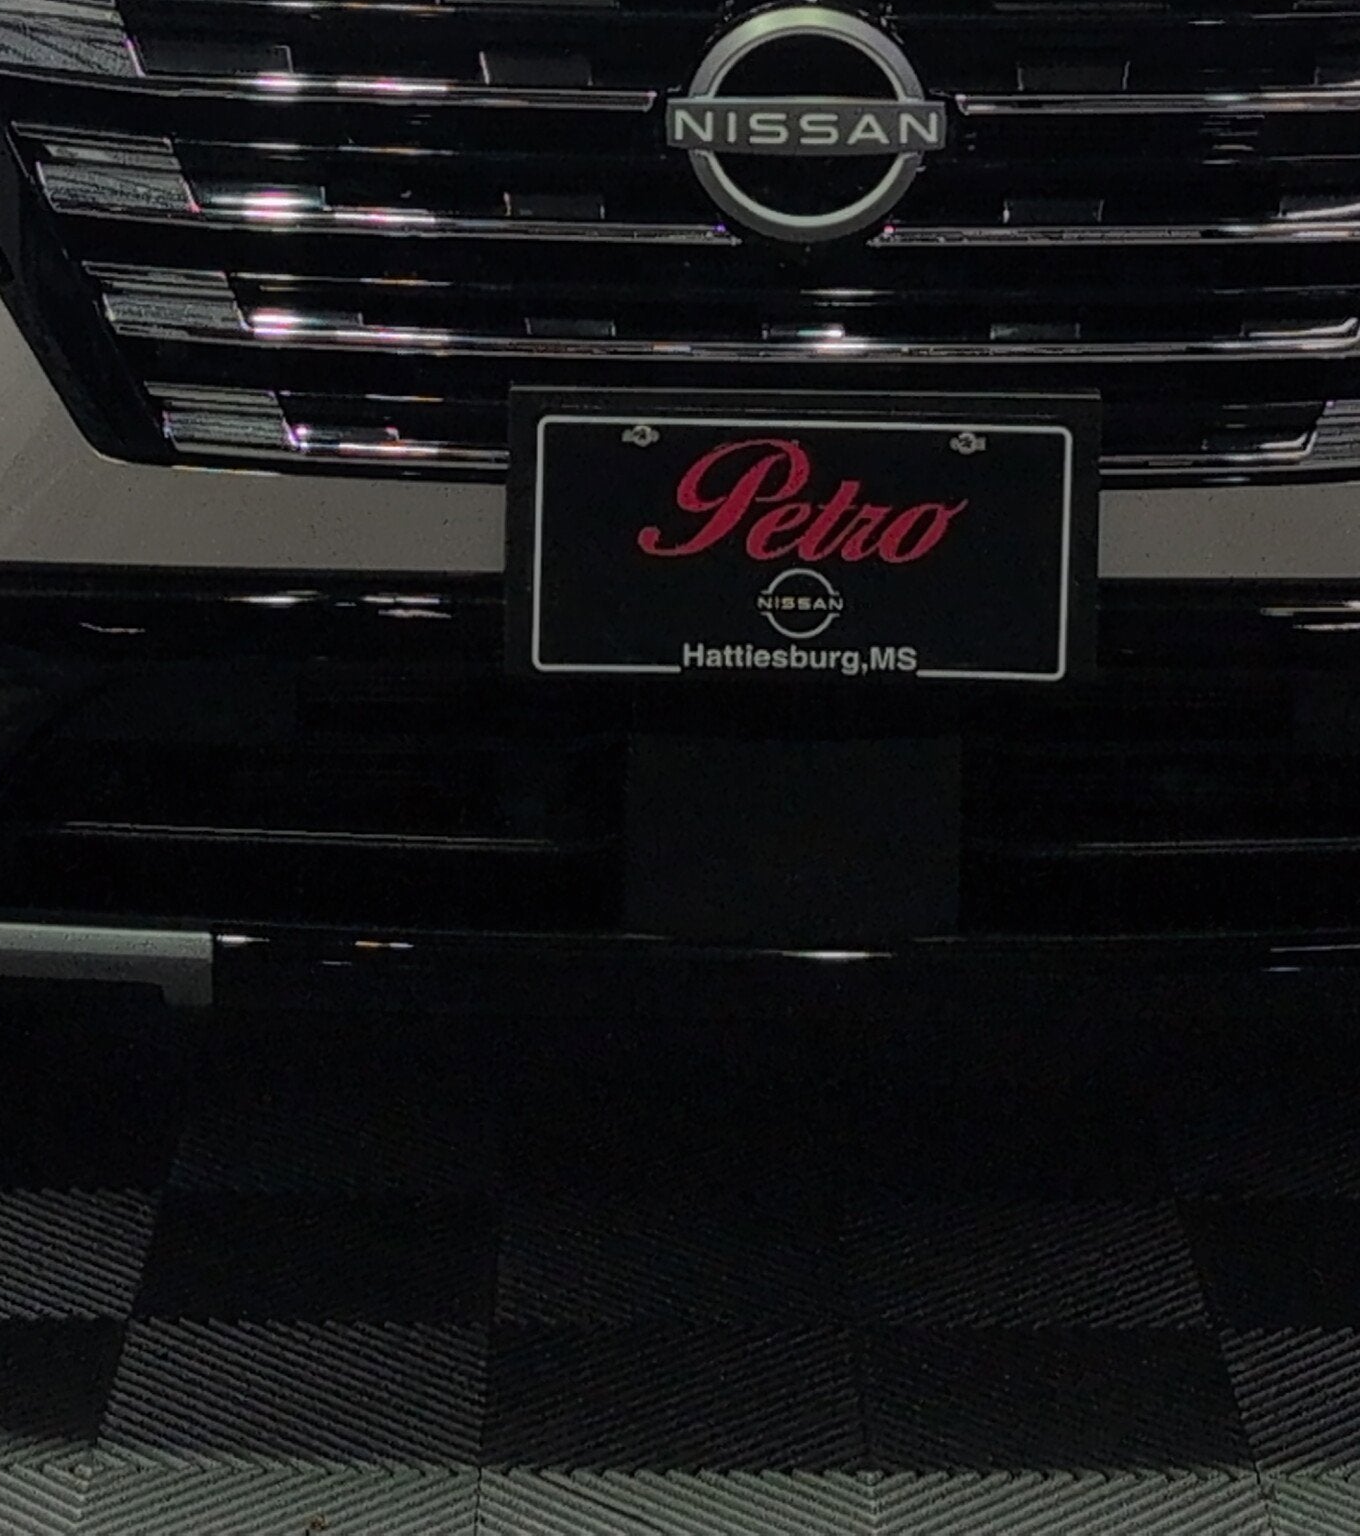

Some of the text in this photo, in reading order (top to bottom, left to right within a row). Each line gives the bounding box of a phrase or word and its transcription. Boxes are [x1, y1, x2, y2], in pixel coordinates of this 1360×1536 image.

[674, 108, 939, 145] NISSAN
[638, 438, 968, 564] Petro
[757, 596, 844, 611] NISSAN
